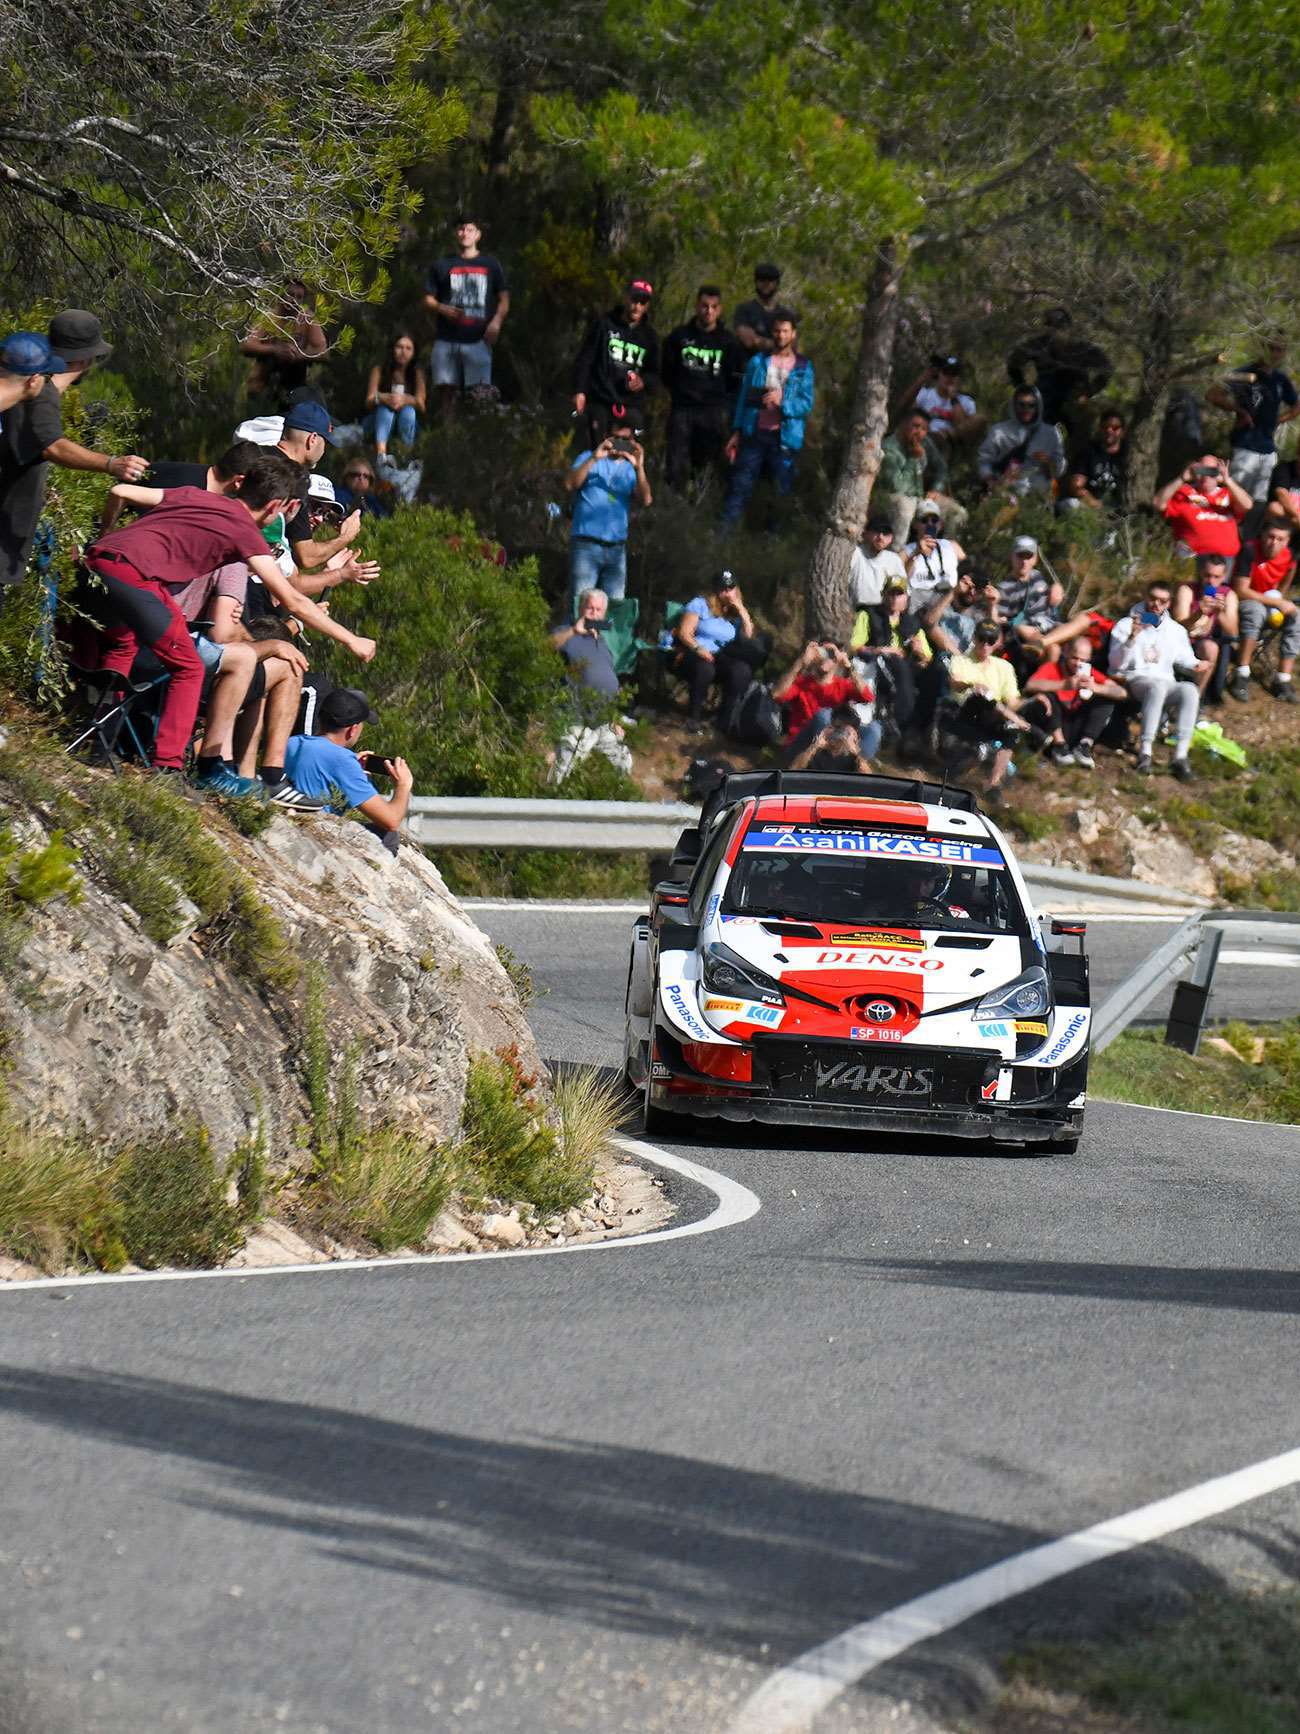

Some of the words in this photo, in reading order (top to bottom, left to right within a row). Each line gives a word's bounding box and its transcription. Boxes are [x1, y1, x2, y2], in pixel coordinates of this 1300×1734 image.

[799, 828, 863, 836] TOYOTA
[867, 831, 926, 842] GAZOO
[816, 952, 945, 970] DENSO
[665, 984, 710, 1040] Panasonic
[858, 1028, 874, 1039] SP
[878, 1029, 902, 1041] 1016
[1038, 1013, 1087, 1064] Panasonic
[816, 1059, 935, 1095] YARIS
